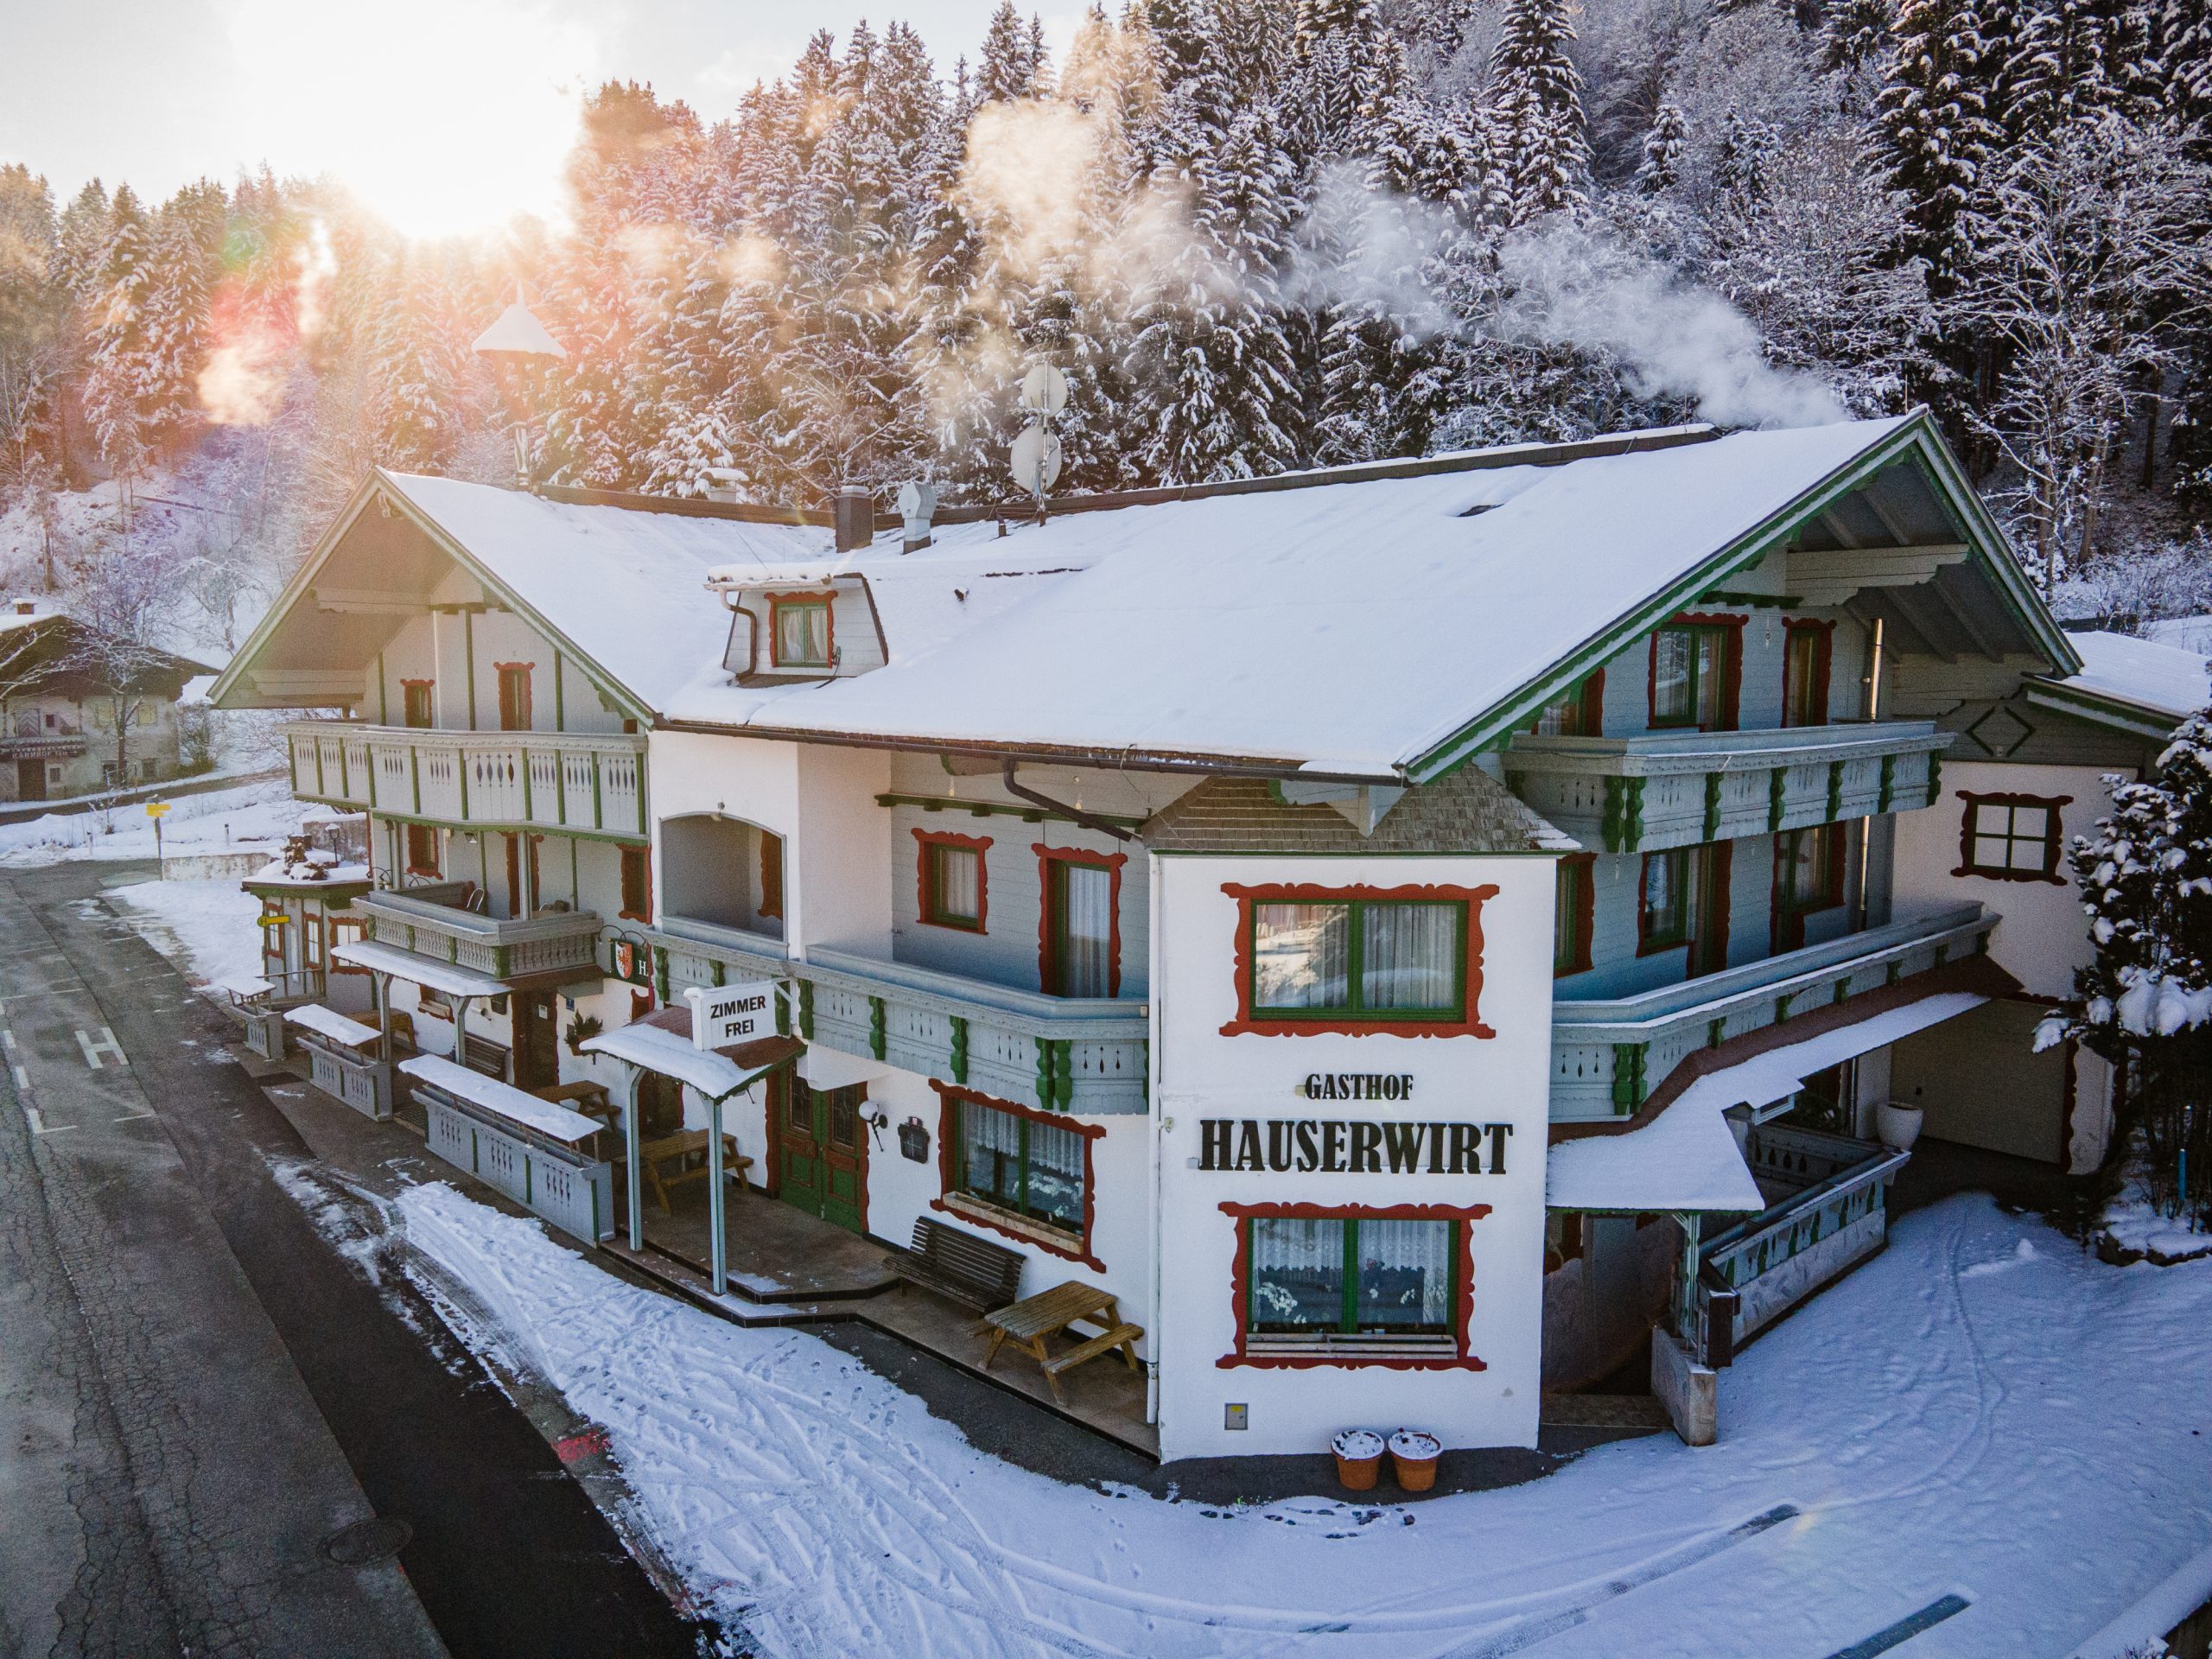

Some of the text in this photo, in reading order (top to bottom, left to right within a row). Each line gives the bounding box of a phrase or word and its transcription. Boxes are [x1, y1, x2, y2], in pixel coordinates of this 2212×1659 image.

[710, 995, 766, 1020] ZIMMER
[725, 1020, 754, 1038] FREI
[1305, 1074, 1414, 1100] GASTHOF
[1198, 1119, 1514, 1175] HAUSERWIRT
